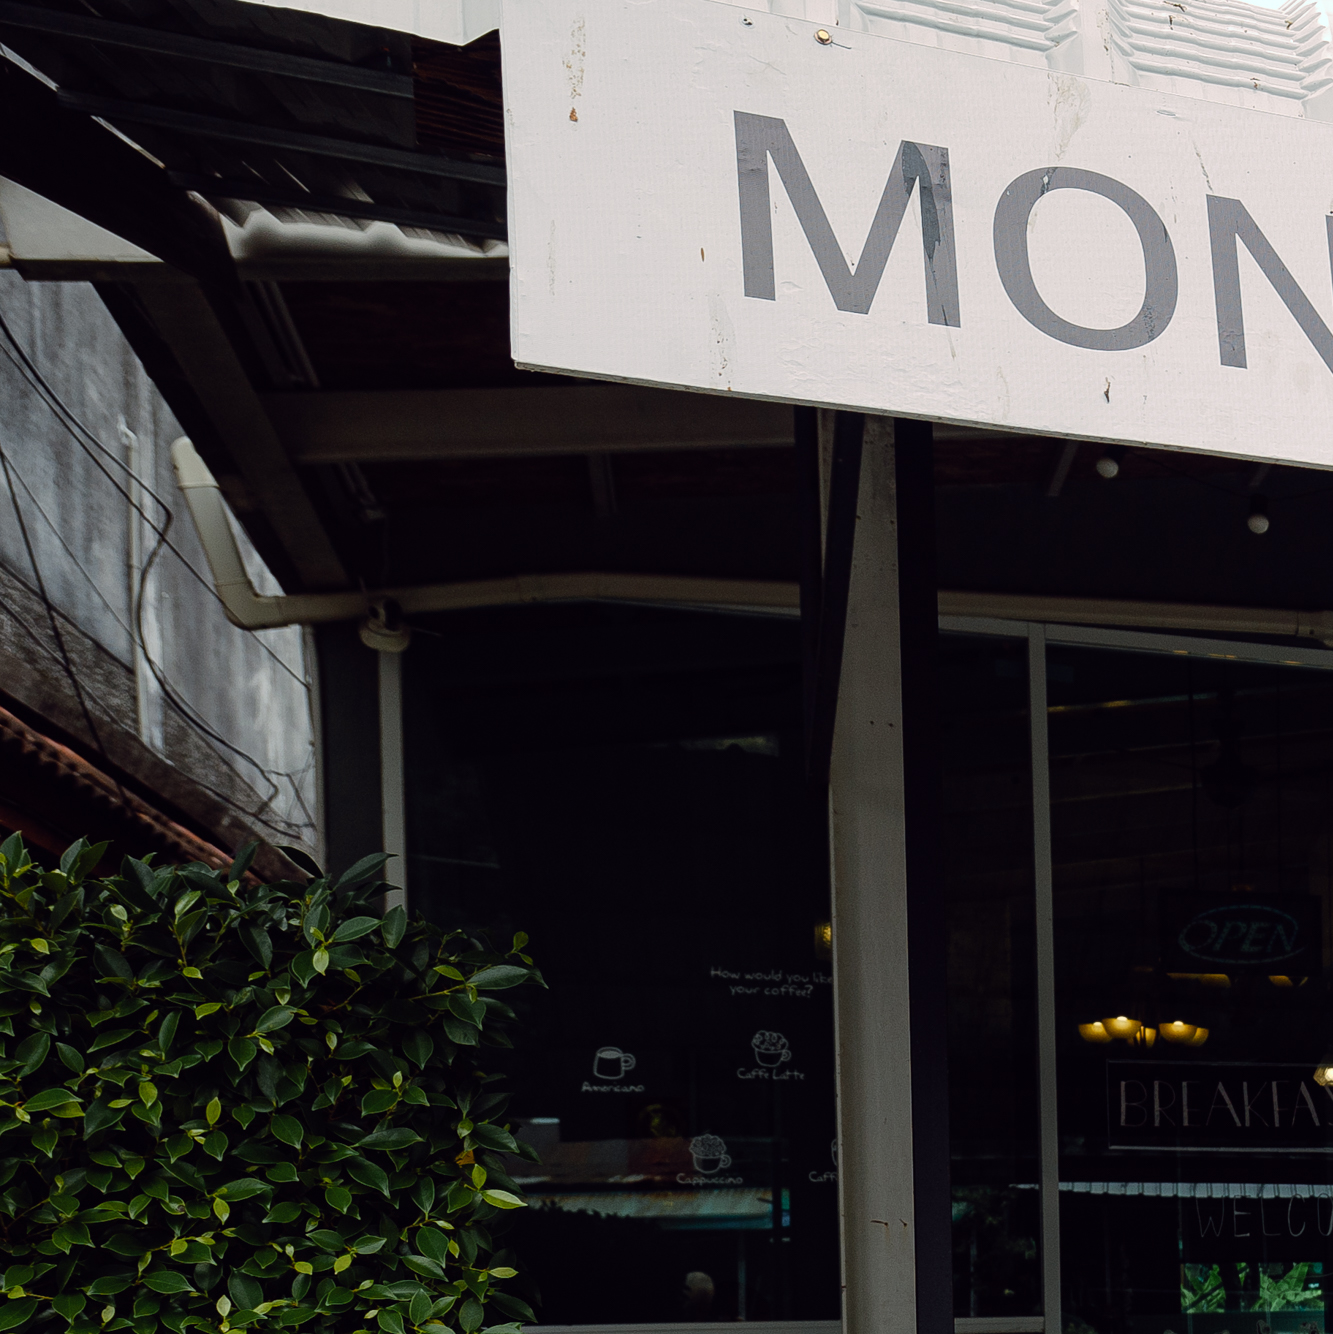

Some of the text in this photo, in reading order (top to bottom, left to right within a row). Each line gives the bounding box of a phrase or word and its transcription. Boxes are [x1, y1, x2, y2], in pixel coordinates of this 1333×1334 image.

[1178, 919, 1298, 953] OPEN
[710, 965, 740, 979] How
[744, 969, 782, 981] would
[786, 973, 809, 984] you
[729, 984, 813, 998] your coffee?
[736, 1068, 805, 1081] Caffe Latte
[580, 1081, 645, 1093] Americano
[676, 1173, 744, 1187] Cappuccino
[808, 1171, 837, 1183] Caff
